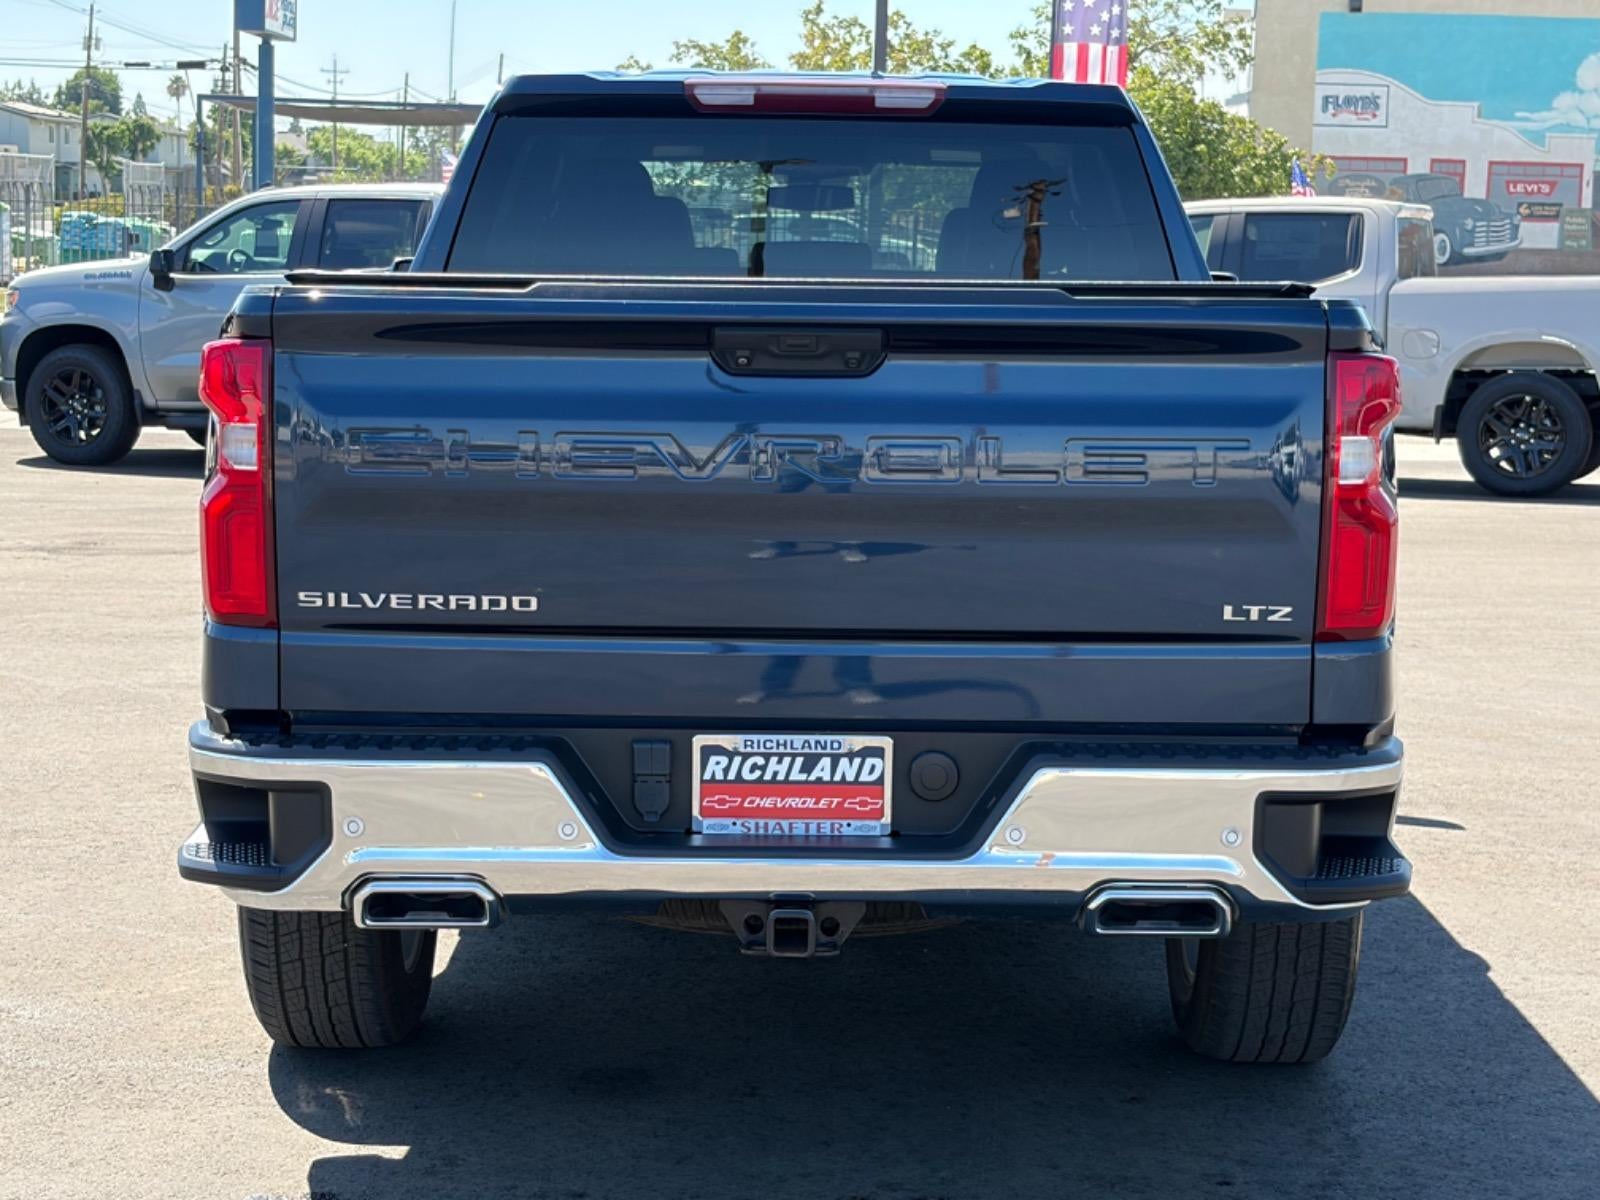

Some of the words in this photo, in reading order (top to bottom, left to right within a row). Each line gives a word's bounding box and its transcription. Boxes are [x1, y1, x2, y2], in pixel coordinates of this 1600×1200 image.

[1508, 183, 1551, 194] LEVI'S
[345, 427, 1251, 487] CHEVROLET
[297, 591, 538, 611] SILVERADO
[1223, 605, 1293, 621] LTZ
[743, 739, 842, 751] RICHLAND
[703, 755, 884, 782] RICHLAND
[743, 796, 843, 809] CHEVROLET
[740, 820, 844, 834] SHAFTER
